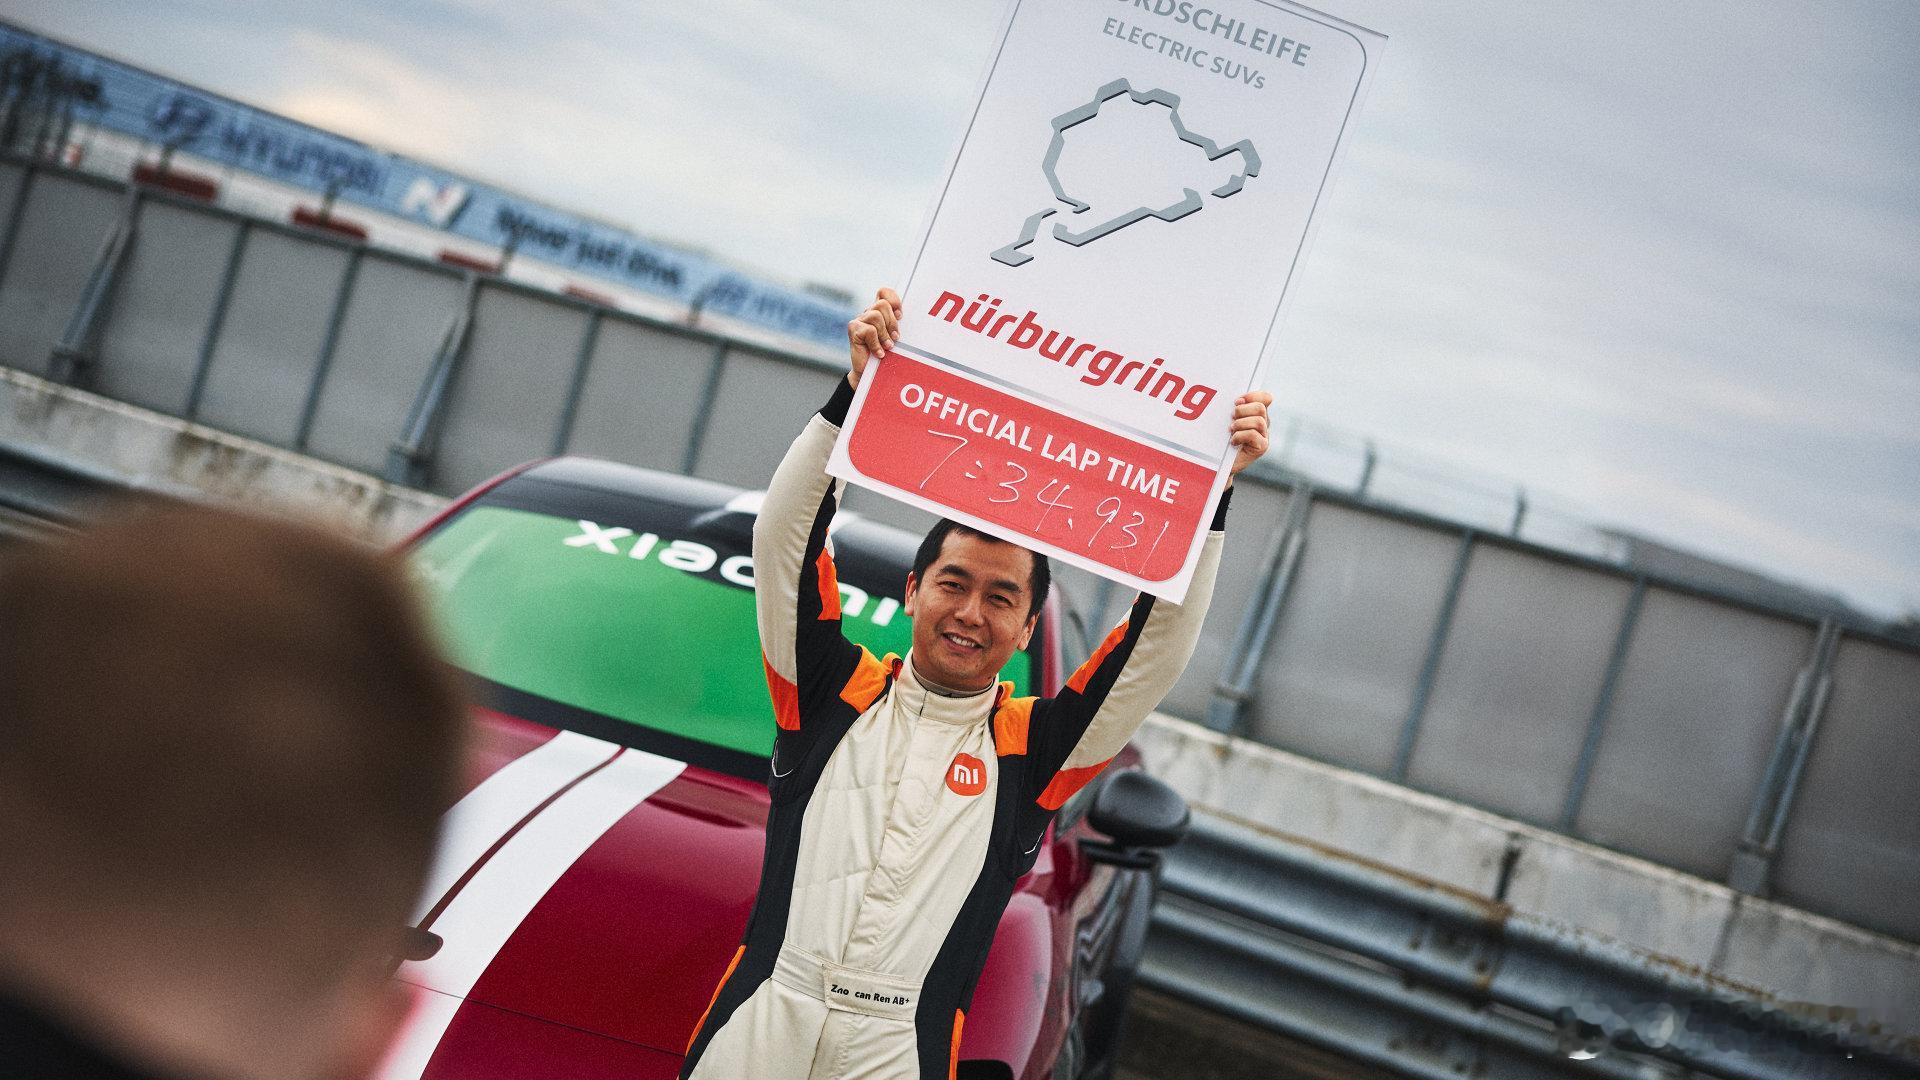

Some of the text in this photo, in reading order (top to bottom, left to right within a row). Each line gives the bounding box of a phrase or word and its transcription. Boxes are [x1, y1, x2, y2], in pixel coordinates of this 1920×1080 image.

[1102, 17, 1266, 90] ELECTRIC SUVs
[1118, 0, 1311, 67] DSCHLEIFE
[928, 290, 1218, 421] nürburgring
[900, 384, 1181, 505] OFFICIAL LAP TIME
[855, 991, 871, 1000] can
[873, 993, 890, 1004] Ren
[892, 996, 909, 1006] AB+
